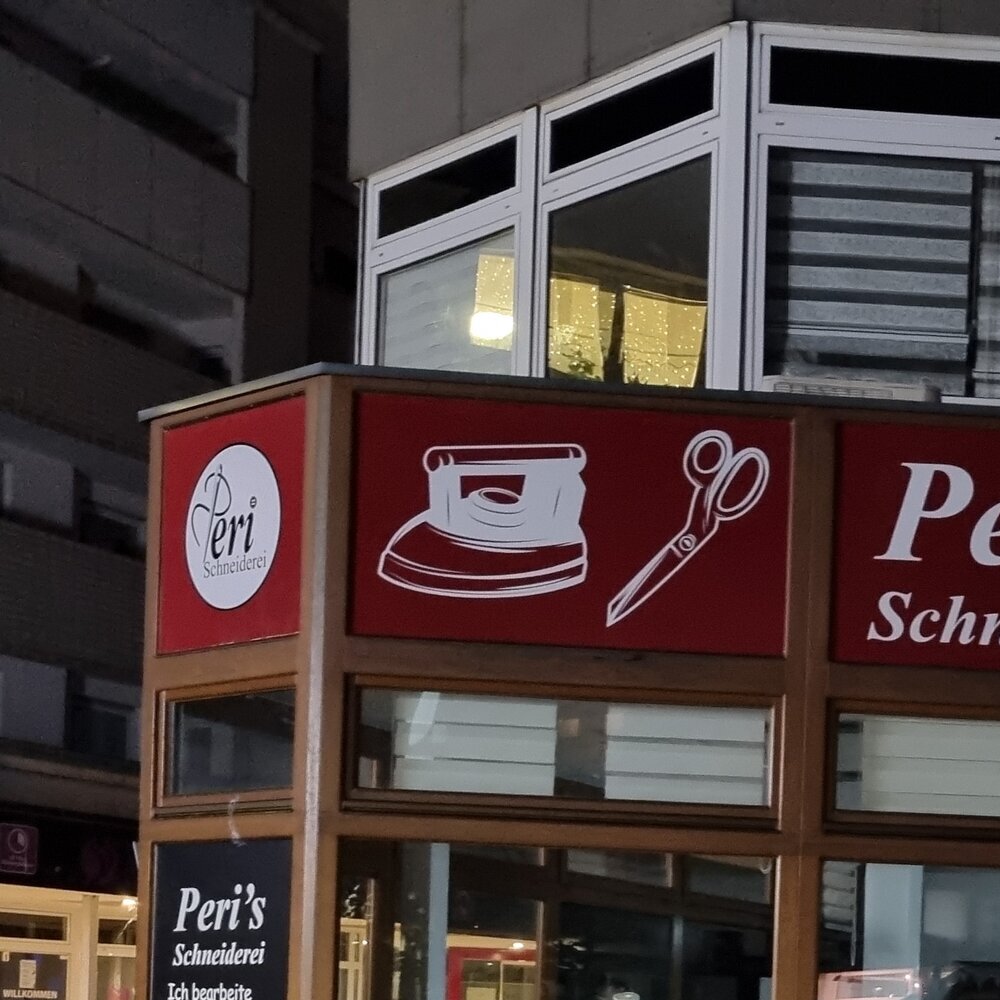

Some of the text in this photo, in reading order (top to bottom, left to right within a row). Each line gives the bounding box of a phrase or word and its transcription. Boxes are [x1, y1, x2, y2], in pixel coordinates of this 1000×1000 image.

[192, 464, 257, 562] Peri
[203, 550, 267, 578] Schneiderei
[173, 883, 267, 932] Peri's
[172, 941, 266, 966] Schneiderei
[3, 989, 58, 999] WILLKOMMEN
[167, 982, 189, 1000] Ich
